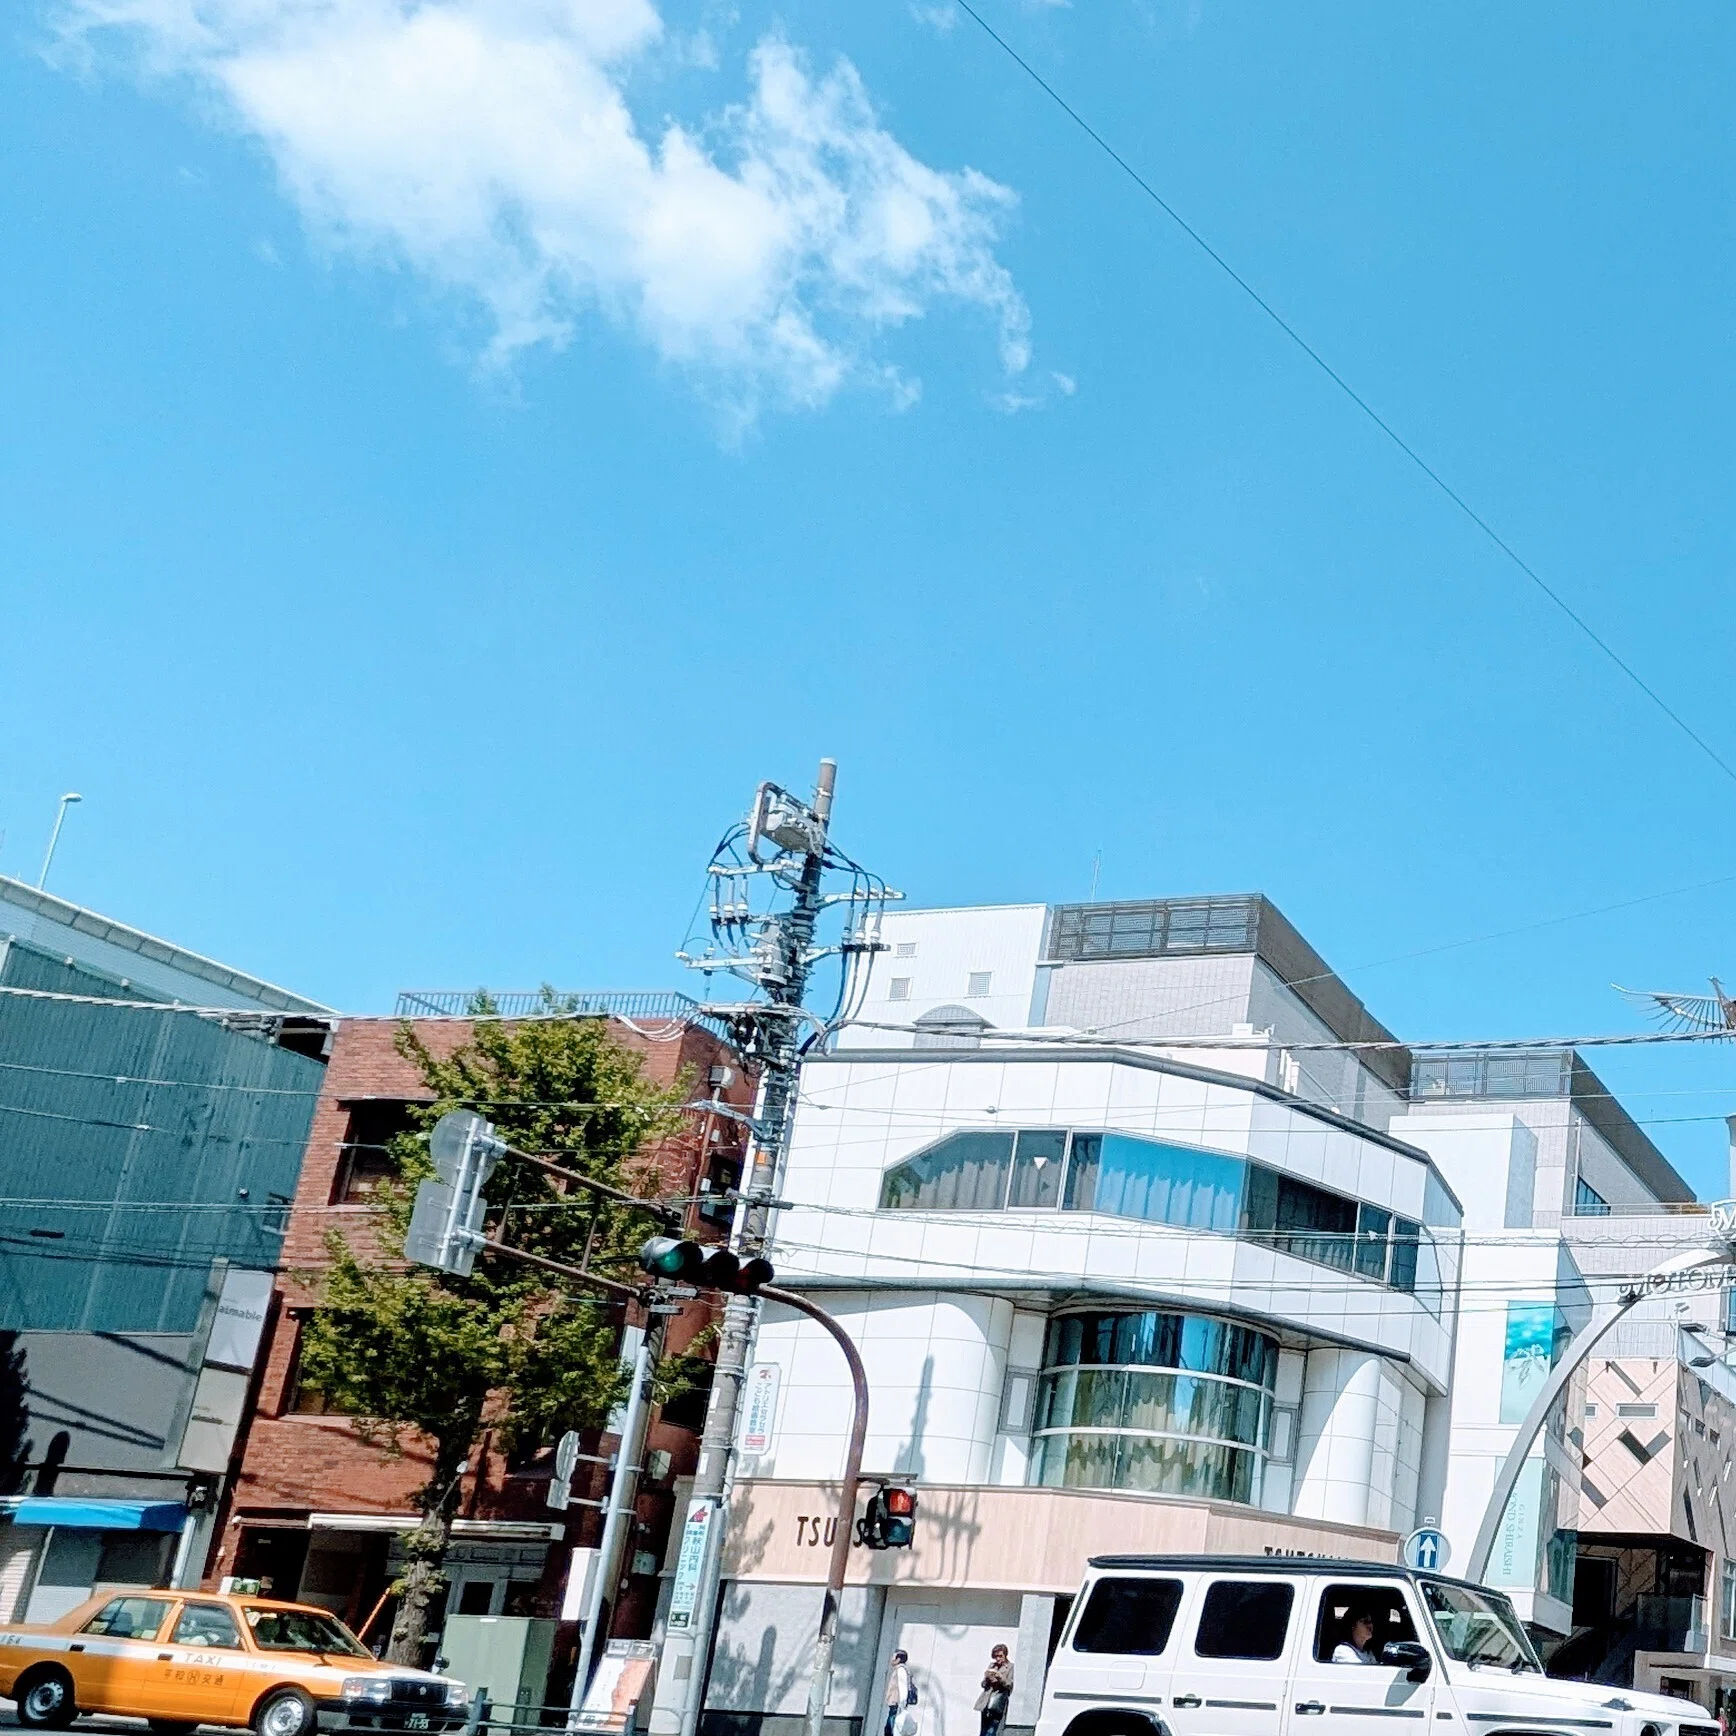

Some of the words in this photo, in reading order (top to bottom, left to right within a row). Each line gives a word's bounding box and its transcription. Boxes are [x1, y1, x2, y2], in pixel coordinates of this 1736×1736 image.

[218, 1304, 263, 1322] aimable
[1502, 1523, 1515, 1575] SHIRAISHI
[185, 1652, 222, 1666] TAXI
